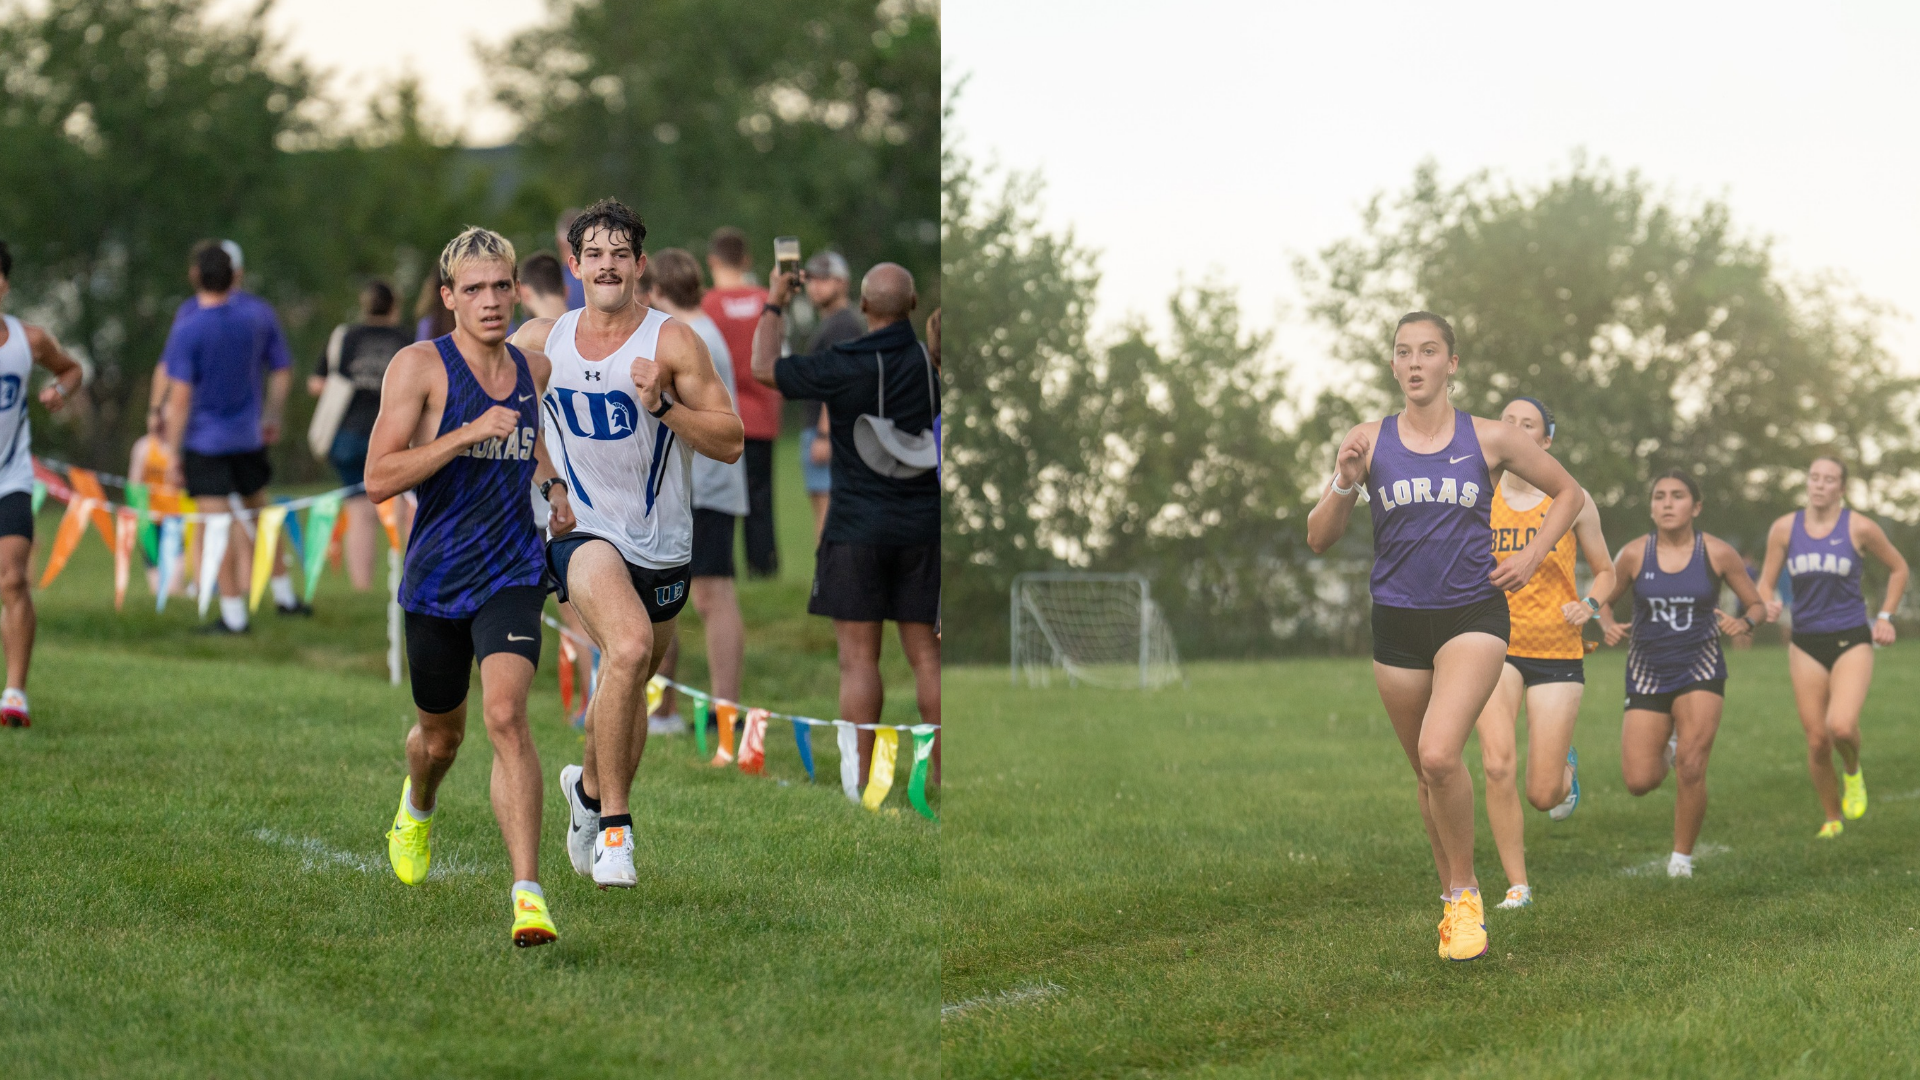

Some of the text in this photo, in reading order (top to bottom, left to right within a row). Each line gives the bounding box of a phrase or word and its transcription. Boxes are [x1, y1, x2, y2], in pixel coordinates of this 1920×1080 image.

[554, 386, 638, 441] UD
[1378, 477, 1480, 512] LORAS
[1787, 552, 1852, 577] LORAS
[654, 580, 685, 606] UD
[1647, 596, 1695, 631] RU
